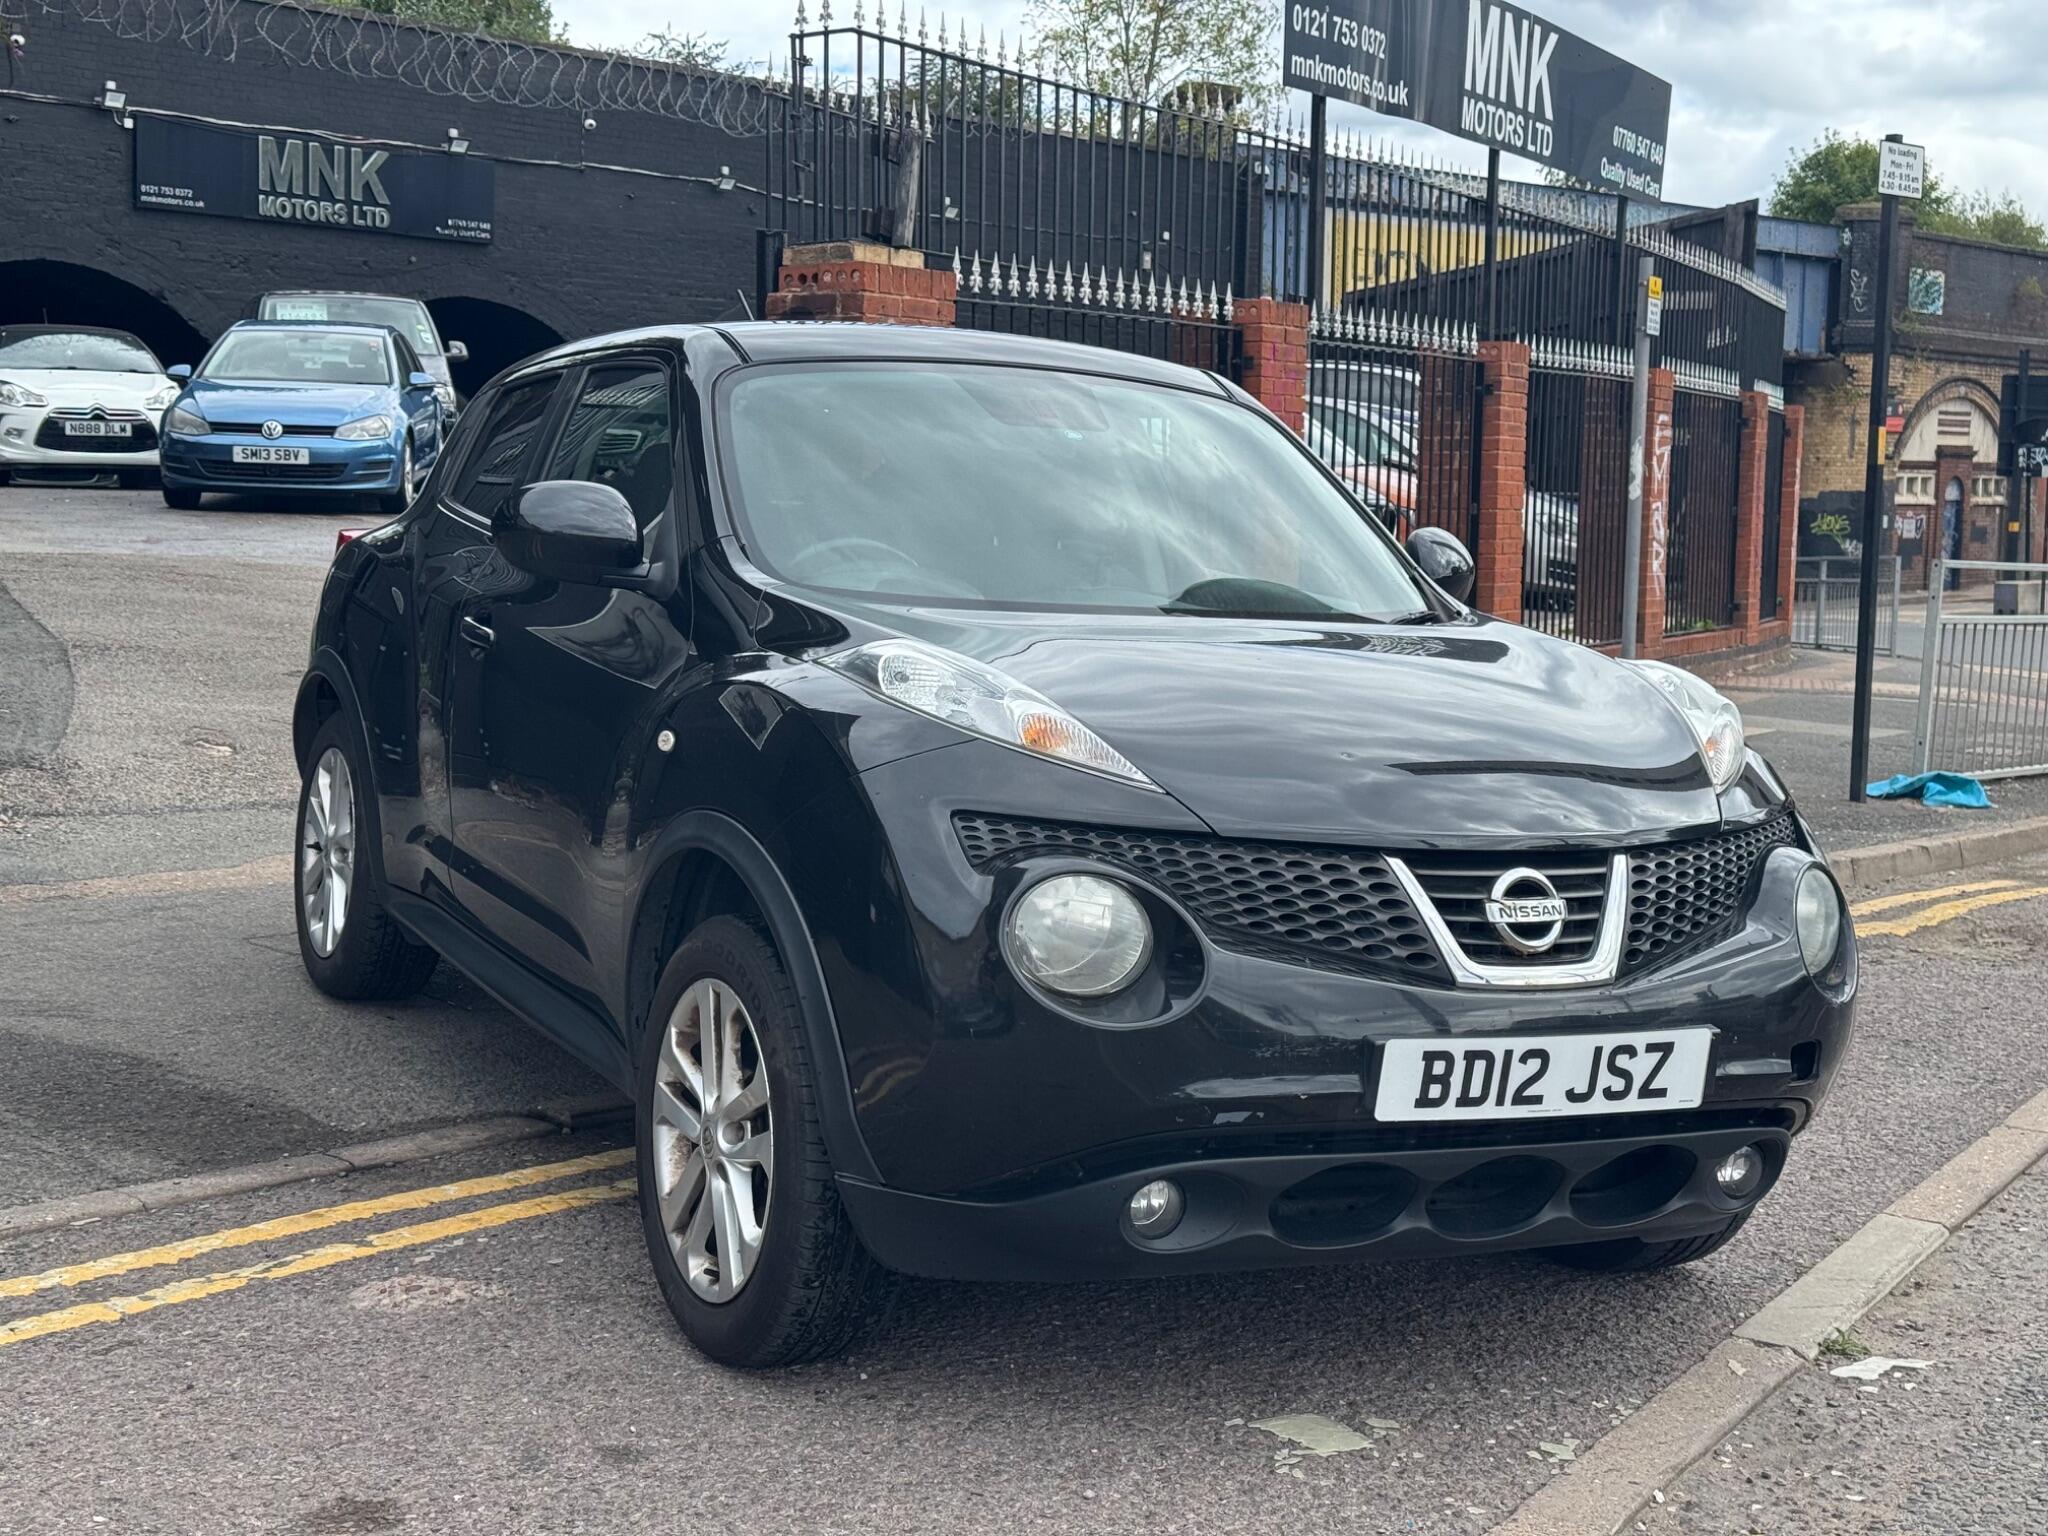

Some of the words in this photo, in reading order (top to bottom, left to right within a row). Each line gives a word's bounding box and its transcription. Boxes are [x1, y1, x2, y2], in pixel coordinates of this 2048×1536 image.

[1293, 4, 1328, 39] 0121
[1333, 15, 1358, 48] 753
[1361, 25, 1386, 59] 0372
[1464, 0, 1559, 121] MNK
[1291, 54, 1409, 107] mnkmotors.co.uk
[1461, 96, 1525, 148] MOTORS
[1527, 119, 1553, 157] LTD
[1636, 135, 1651, 159] 547
[1650, 141, 1664, 166] 648
[1888, 146, 1897, 155] No
[258, 135, 391, 205] MNK
[1600, 156, 1626, 189] Quality
[1626, 167, 1645, 192] Used
[1644, 174, 1660, 198] Cars
[140, 184, 159, 194] 0121
[160, 186, 174, 196] 753
[140, 195, 205, 208] mnkmotors.co.uk
[258, 194, 348, 225] MOTORS
[353, 205, 391, 228] LTD
[69, 423, 101, 434] N888
[104, 423, 128, 434] DLM
[241, 448, 271, 461] SM13
[274, 448, 300, 461] SBV
[1498, 904, 1562, 918] NISSAN
[1414, 1048, 1551, 1109] BD12
[1565, 1041, 1675, 1103] JSZ
